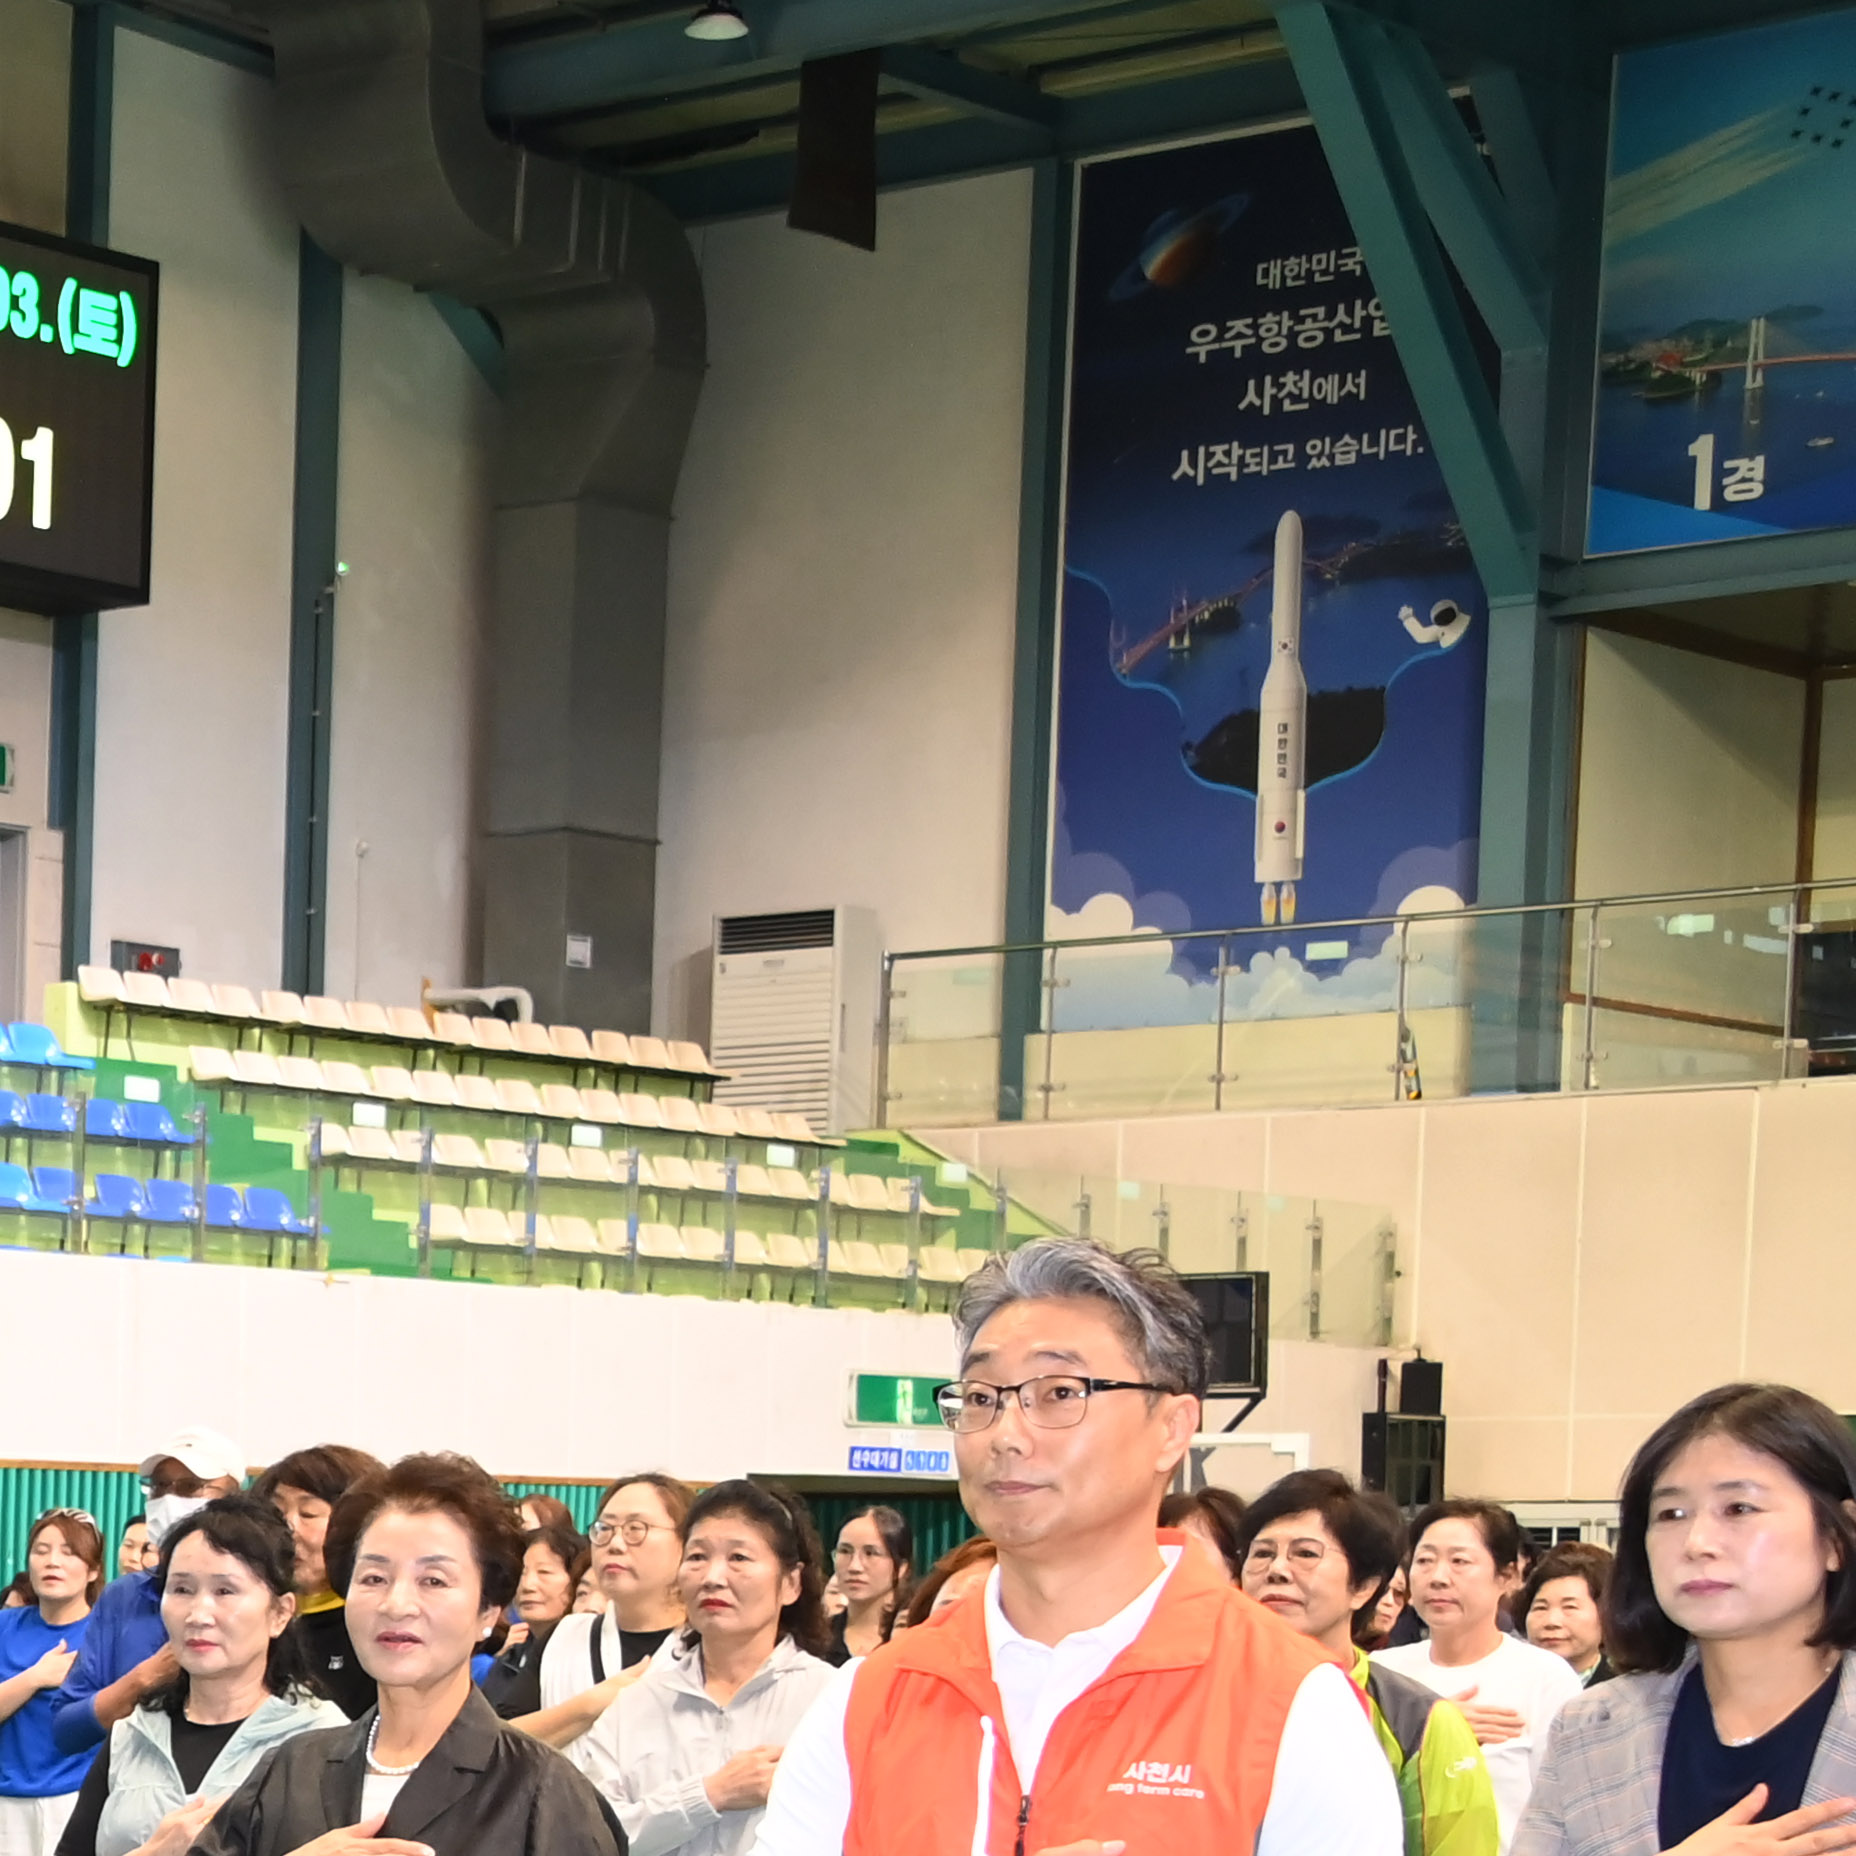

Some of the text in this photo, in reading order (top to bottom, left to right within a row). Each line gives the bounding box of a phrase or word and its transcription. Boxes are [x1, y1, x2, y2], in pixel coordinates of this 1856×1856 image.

[1256, 246, 1363, 290] 대한민국
[1238, 369, 1366, 416] 사천에서
[1172, 424, 1424, 486] 시작되고 있습니다.
[1688, 434, 1764, 511] 1경
[1122, 1760, 1192, 1784] 사천시
